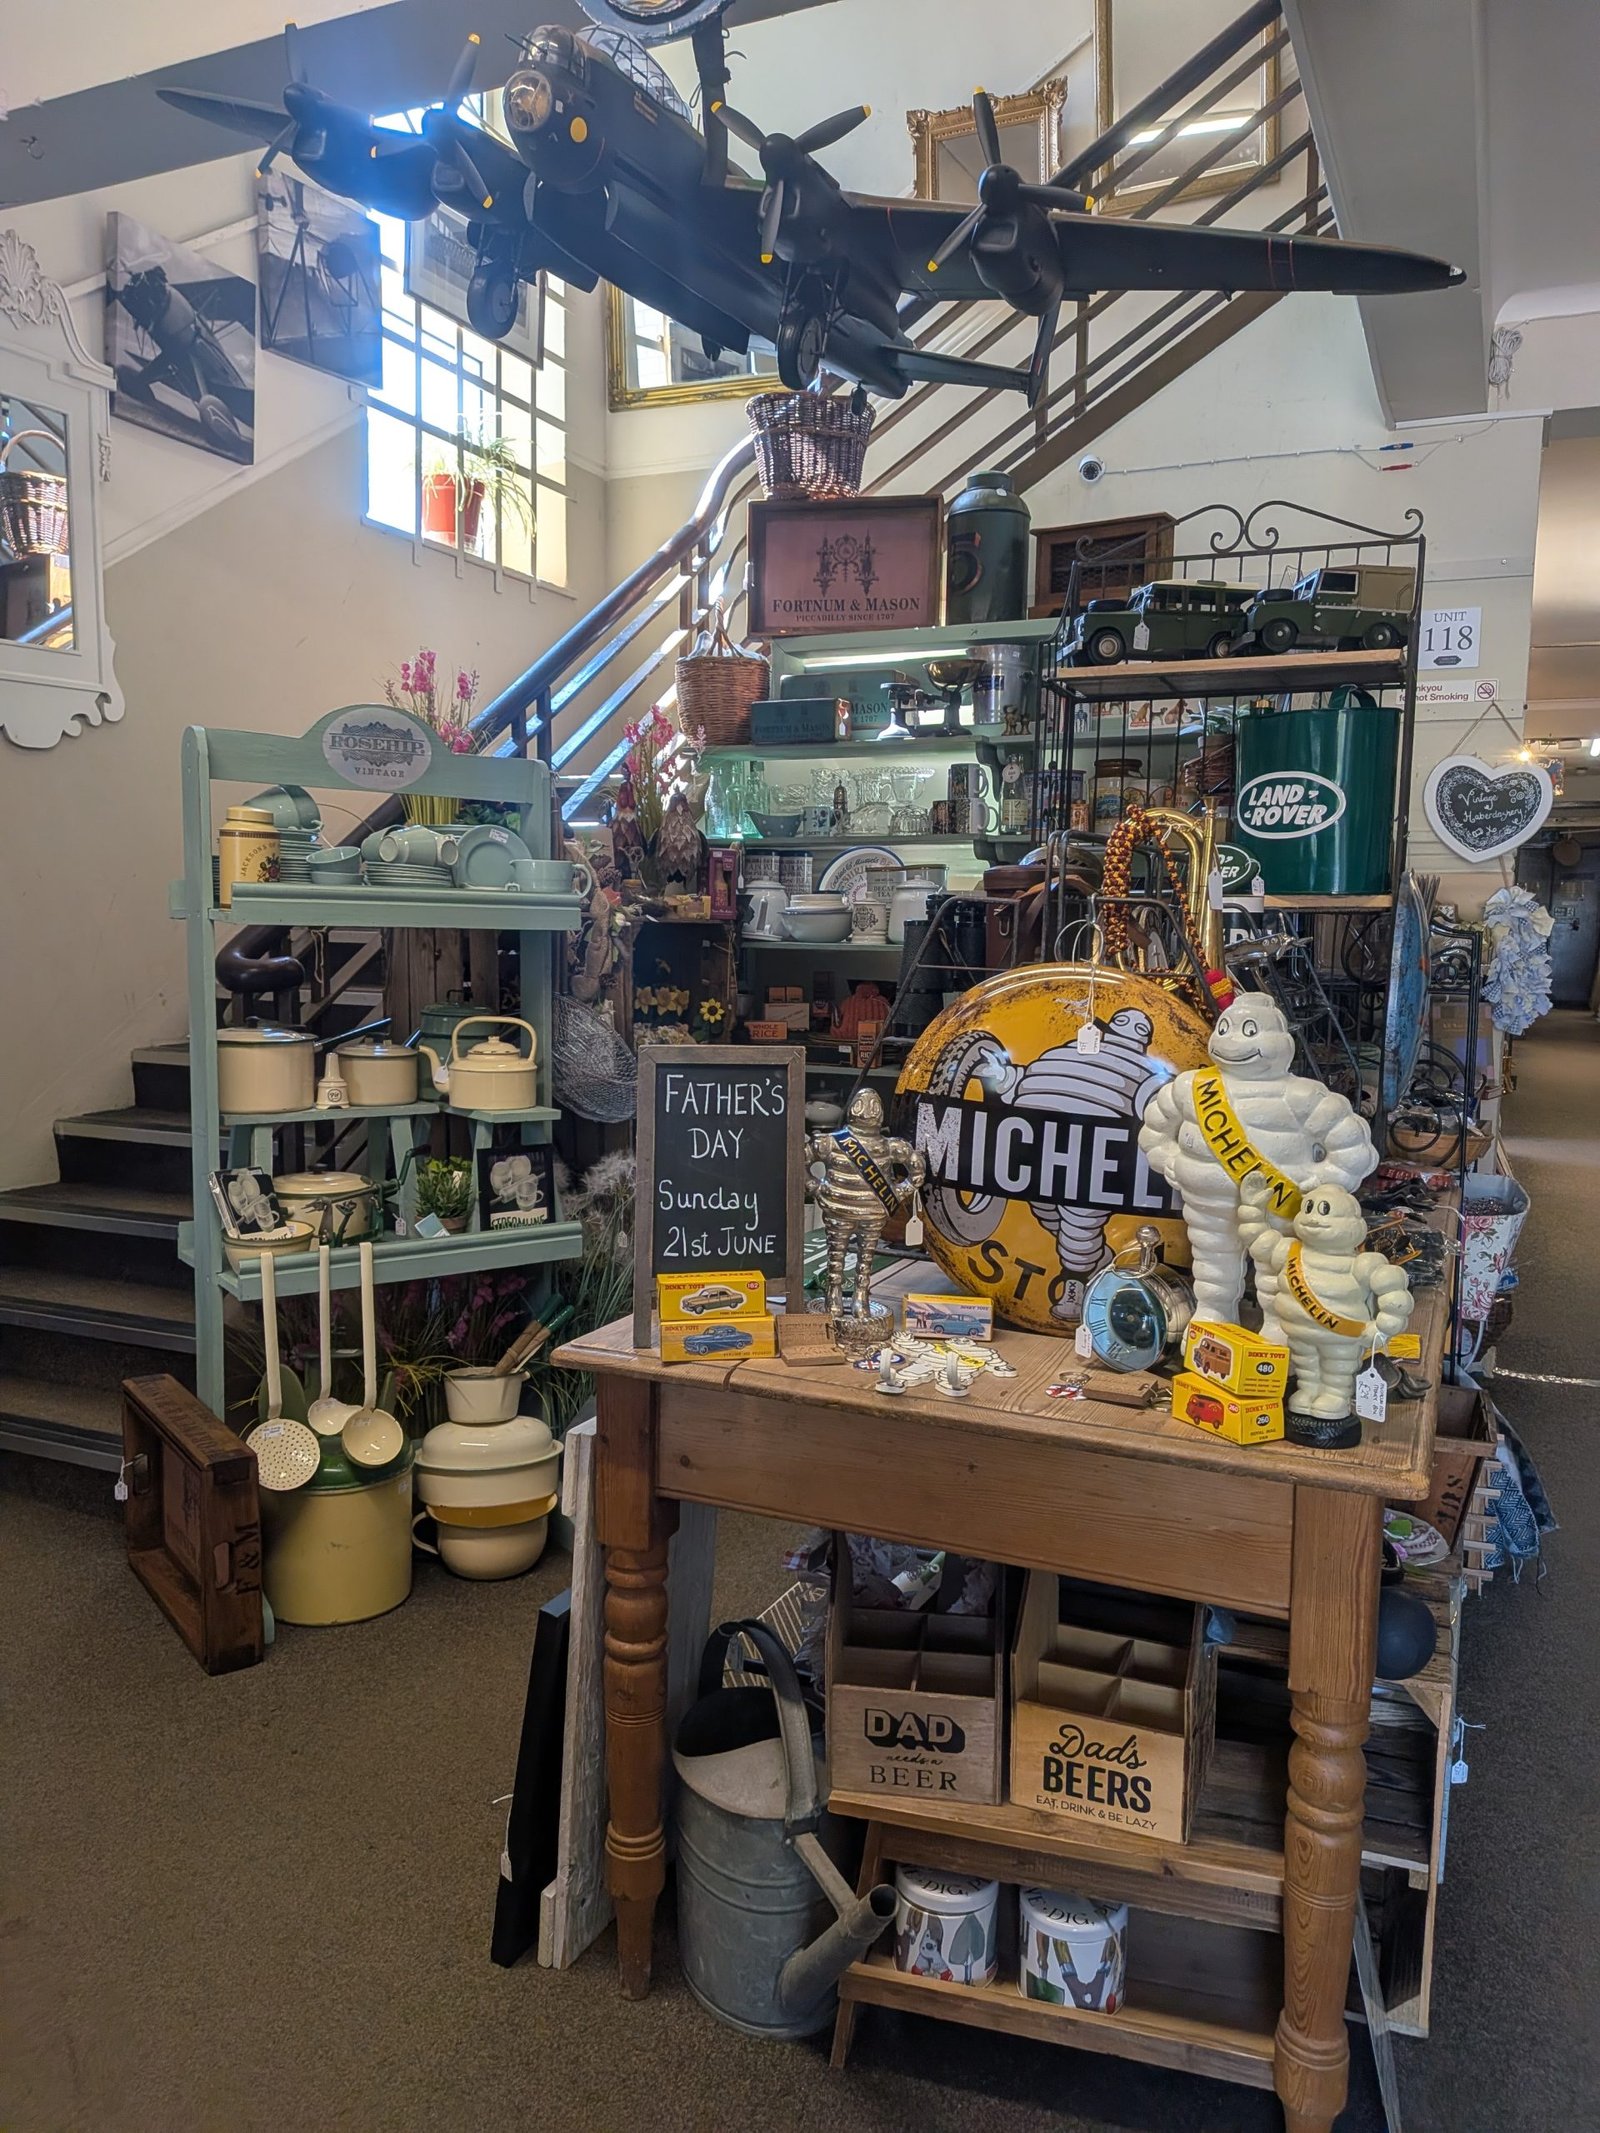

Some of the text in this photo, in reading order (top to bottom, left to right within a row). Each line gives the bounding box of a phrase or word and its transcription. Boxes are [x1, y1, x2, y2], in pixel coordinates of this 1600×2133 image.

[773, 597, 920, 613] FORTNUM & MASON
[796, 614, 846, 622] PICCADILLY
[849, 613, 874, 621] SINCE
[1434, 611, 1467, 622] UNIT
[1424, 625, 1473, 652] 118
[1429, 692, 1469, 702] Smoking
[354, 767, 405, 778] VINTAGE
[1249, 784, 1304, 806] LAND
[1458, 788, 1498, 810] Vintage
[1251, 804, 1328, 826] ROVER
[240, 844, 268, 877] JACKSONS
[752, 1030, 778, 1038] RICE
[665, 1074, 785, 1117] FATHER'S
[687, 1128, 744, 1159] DAY
[841, 1137, 897, 1213] MICHELIN
[658, 1179, 759, 1231] Sunday
[663, 1226, 777, 1257] 21st JUNE
[1287, 1256, 1339, 1329] MICHELIN
[1257, 1364, 1273, 1372] 480
[1245, 1402, 1279, 1413] DINKY TOYS
[1257, 1415, 1270, 1424] 260
[865, 1708, 965, 1754] DAD
[1049, 1724, 1148, 1769] Dad's
[869, 1765, 958, 1791] BEER
[1043, 1756, 1152, 1813] BEERS
[1061, 1800, 1096, 1817] DRINK
[1098, 1810, 1106, 1819] &
[1108, 1811, 1124, 1823] BE
[1125, 1815, 1158, 1831] LAZY
